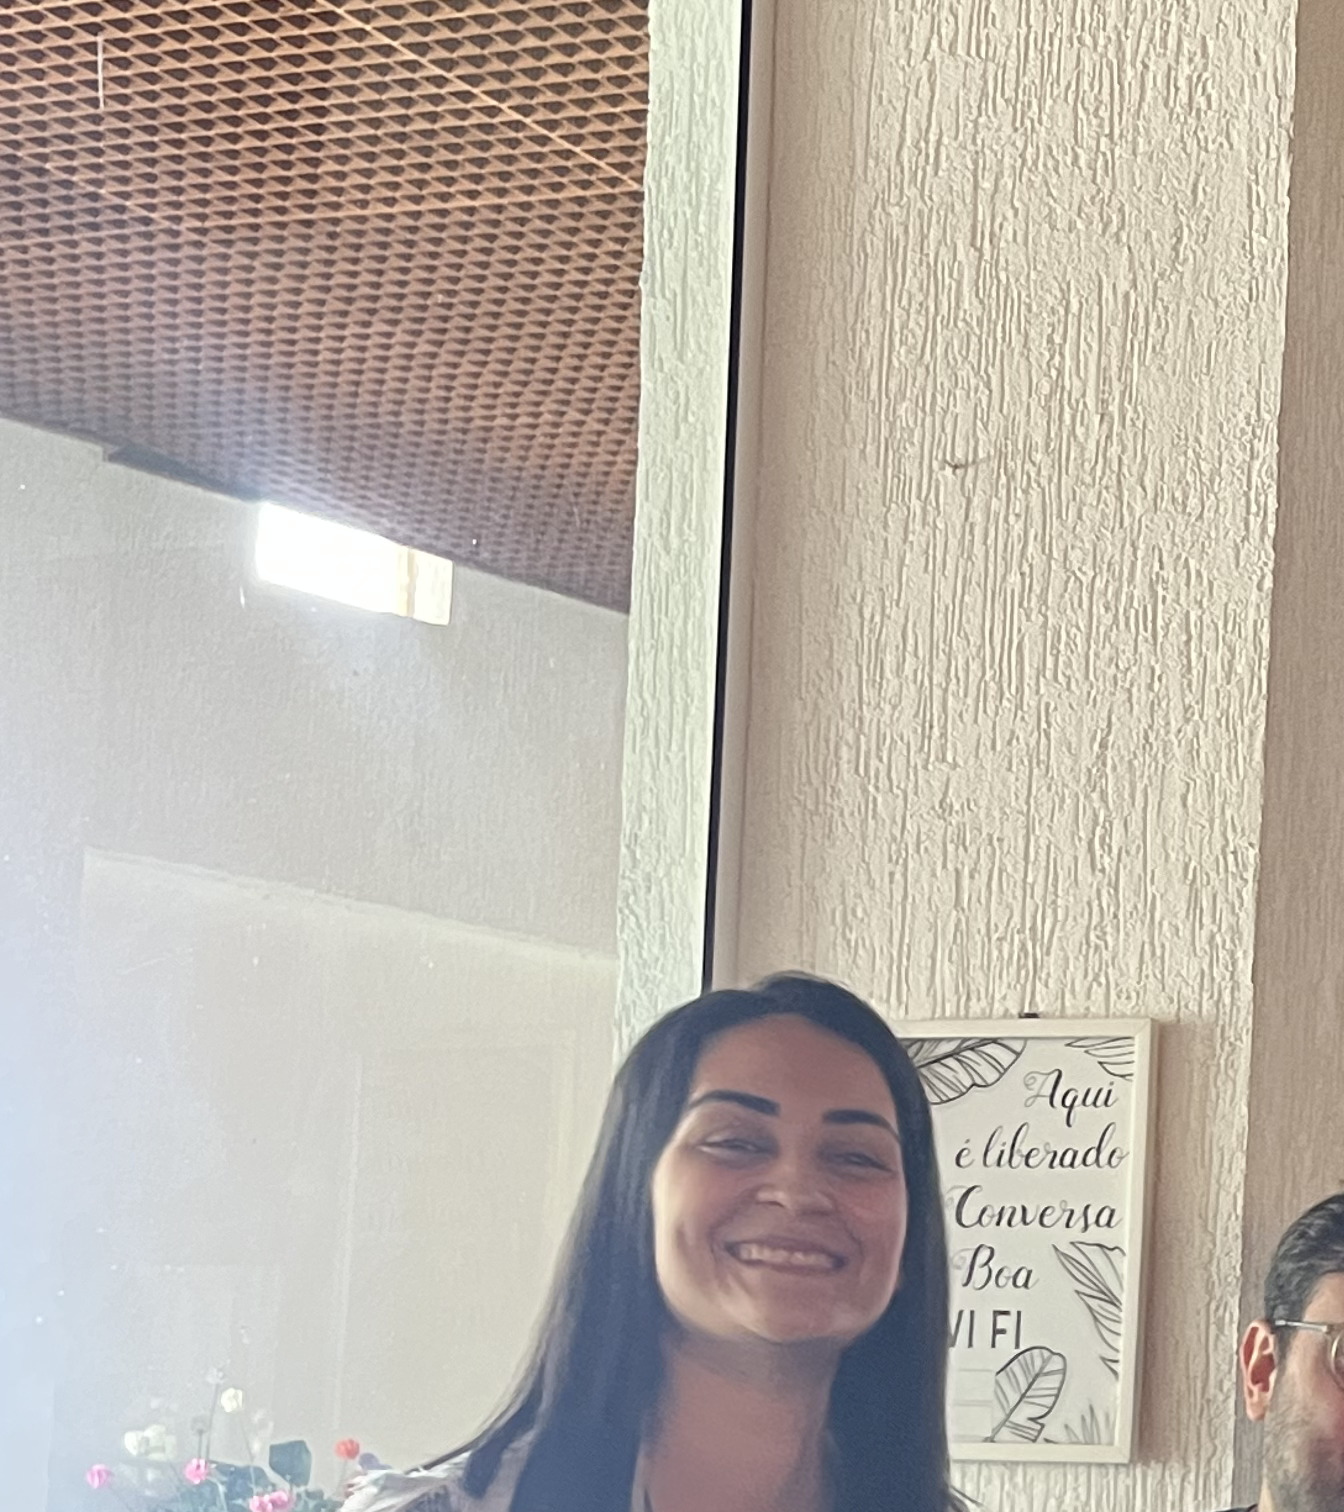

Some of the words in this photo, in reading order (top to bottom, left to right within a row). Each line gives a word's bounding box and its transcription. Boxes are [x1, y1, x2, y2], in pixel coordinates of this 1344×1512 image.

[1023, 1068, 1119, 1127] Aqui
[955, 1138, 976, 1169] é
[982, 1121, 1129, 1170] liberado
[945, 1184, 1121, 1233] Conversa
[953, 1243, 1038, 1291] Boa
[991, 1310, 1022, 1350] FI
